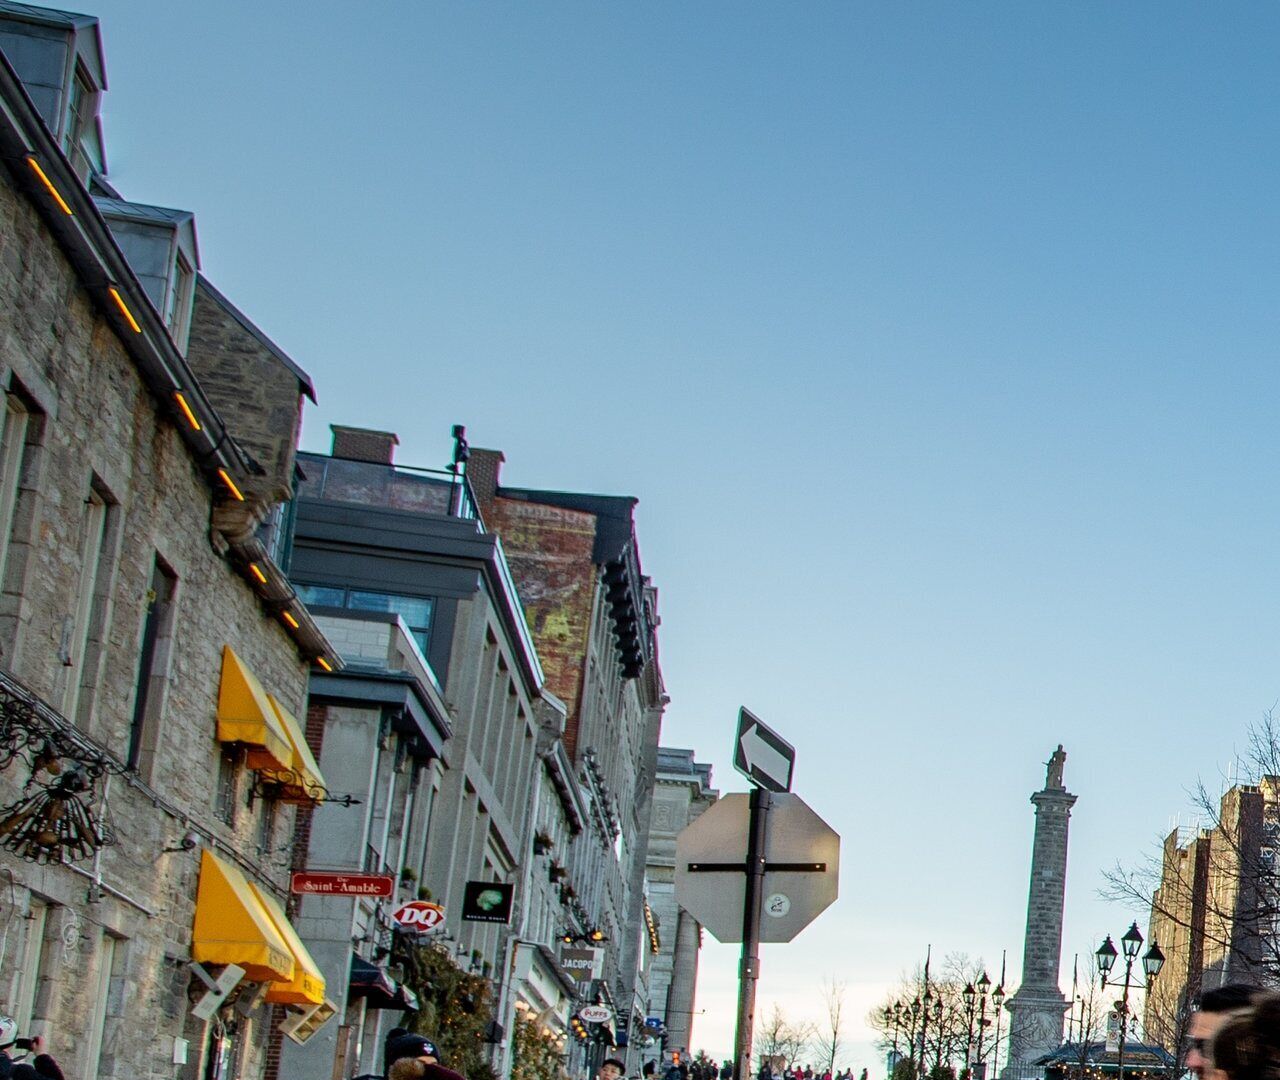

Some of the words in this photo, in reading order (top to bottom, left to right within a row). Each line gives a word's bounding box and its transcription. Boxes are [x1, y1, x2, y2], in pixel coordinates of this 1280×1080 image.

[303, 881, 381, 893] Saint-Amable
[401, 907, 437, 926] DQ
[562, 959, 592, 969] JACOPO
